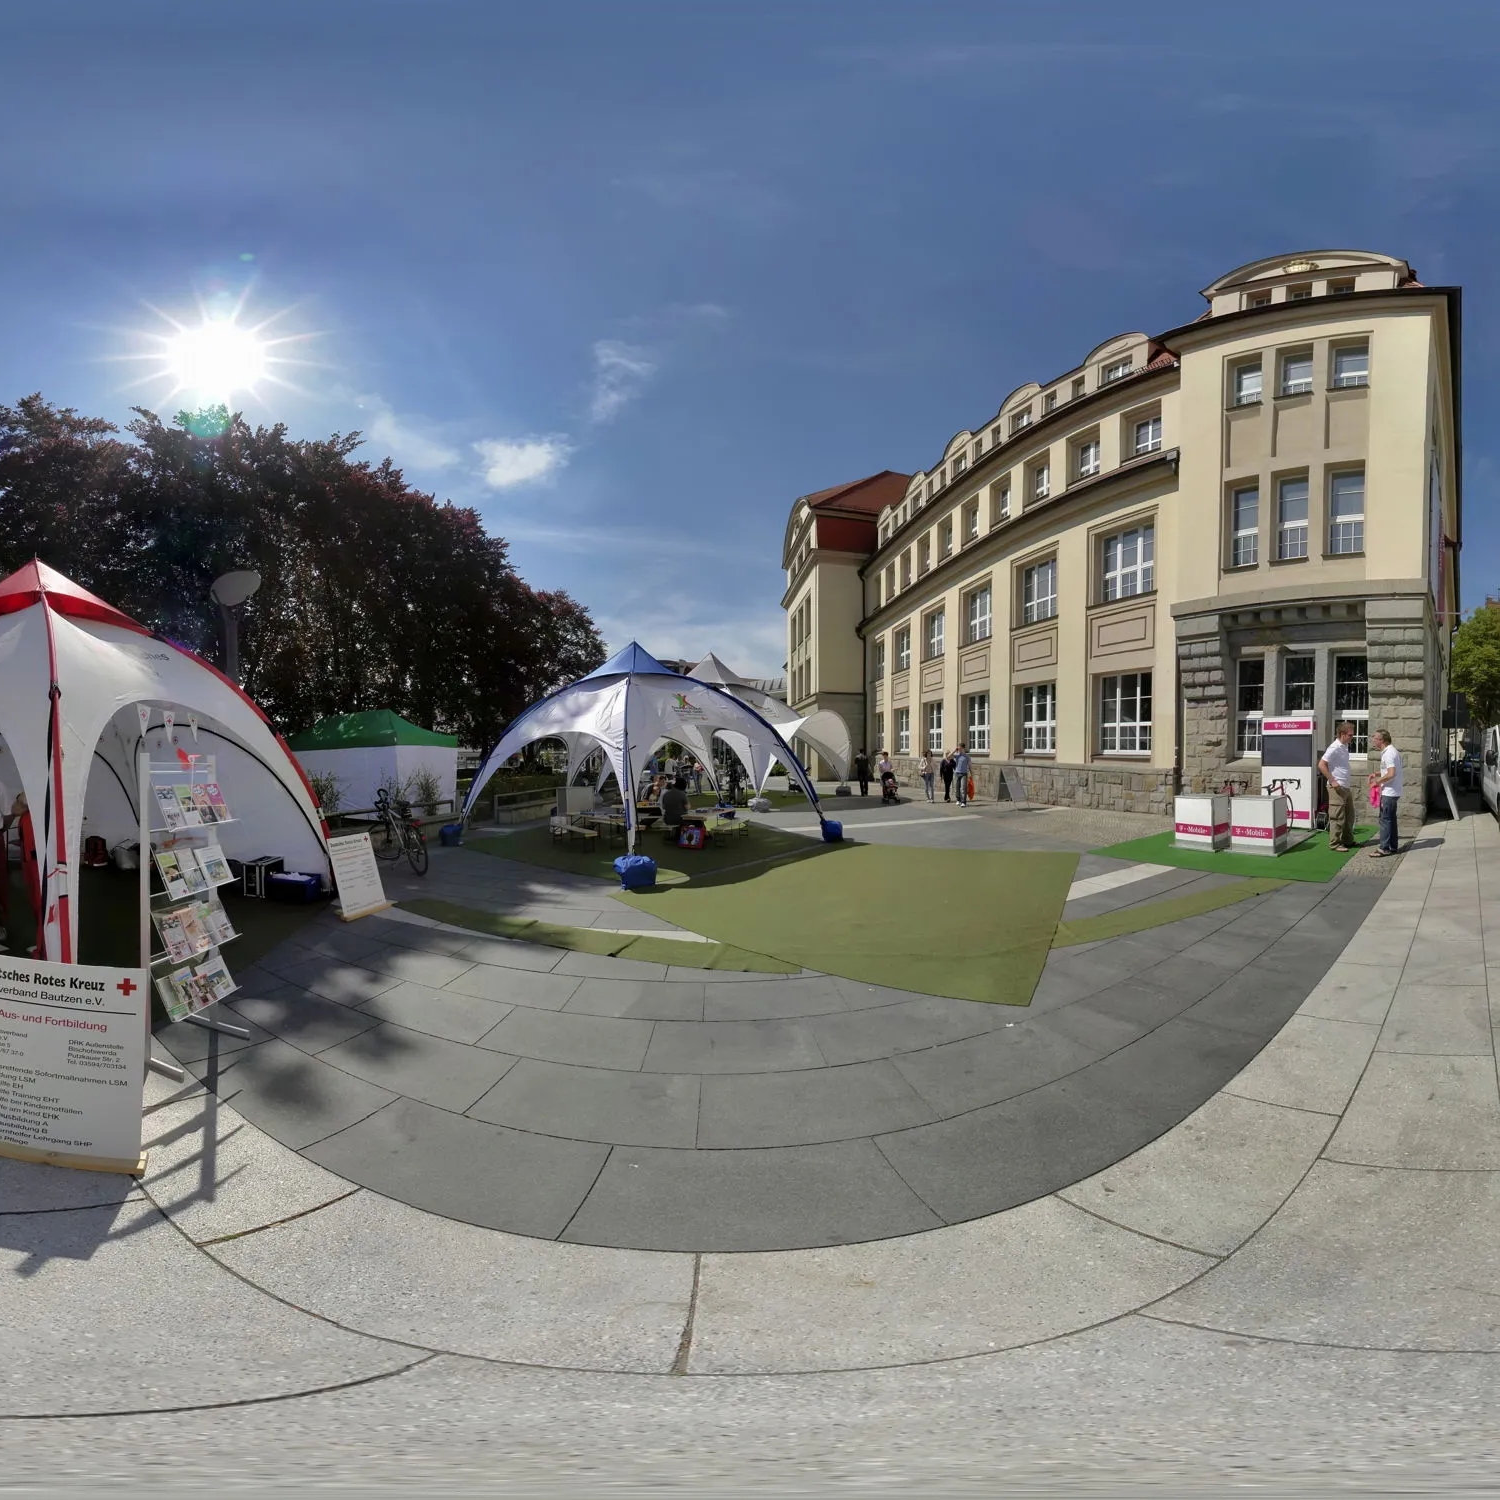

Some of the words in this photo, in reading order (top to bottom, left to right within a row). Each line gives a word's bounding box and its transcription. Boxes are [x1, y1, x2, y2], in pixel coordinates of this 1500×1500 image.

[33, 973, 66, 987] Rotes
[69, 977, 105, 992] Kreuz
[40, 991, 82, 1005] Bautzen
[85, 997, 105, 1007] e.V.
[22, 1015, 43, 1025] und
[45, 1017, 108, 1033] Fortbildung
[68, 1046, 117, 1056] Bischofswerda
[85, 1041, 124, 1050] Außenstelle
[67, 1052, 100, 1061] Putzkauer
[18, 1075, 36, 1083] LSM
[35, 1069, 107, 1085] Sofortmaßnahmen
[108, 1079, 128, 1087] LSM
[12, 1090, 41, 1101] Training
[23, 1101, 83, 1115] Kindernotfällen
[22, 1109, 41, 1117] Kind
[42, 1112, 60, 1120] EHK
[3, 1135, 29, 1145] Pflege
[33, 1134, 72, 1146] Lehrgang
